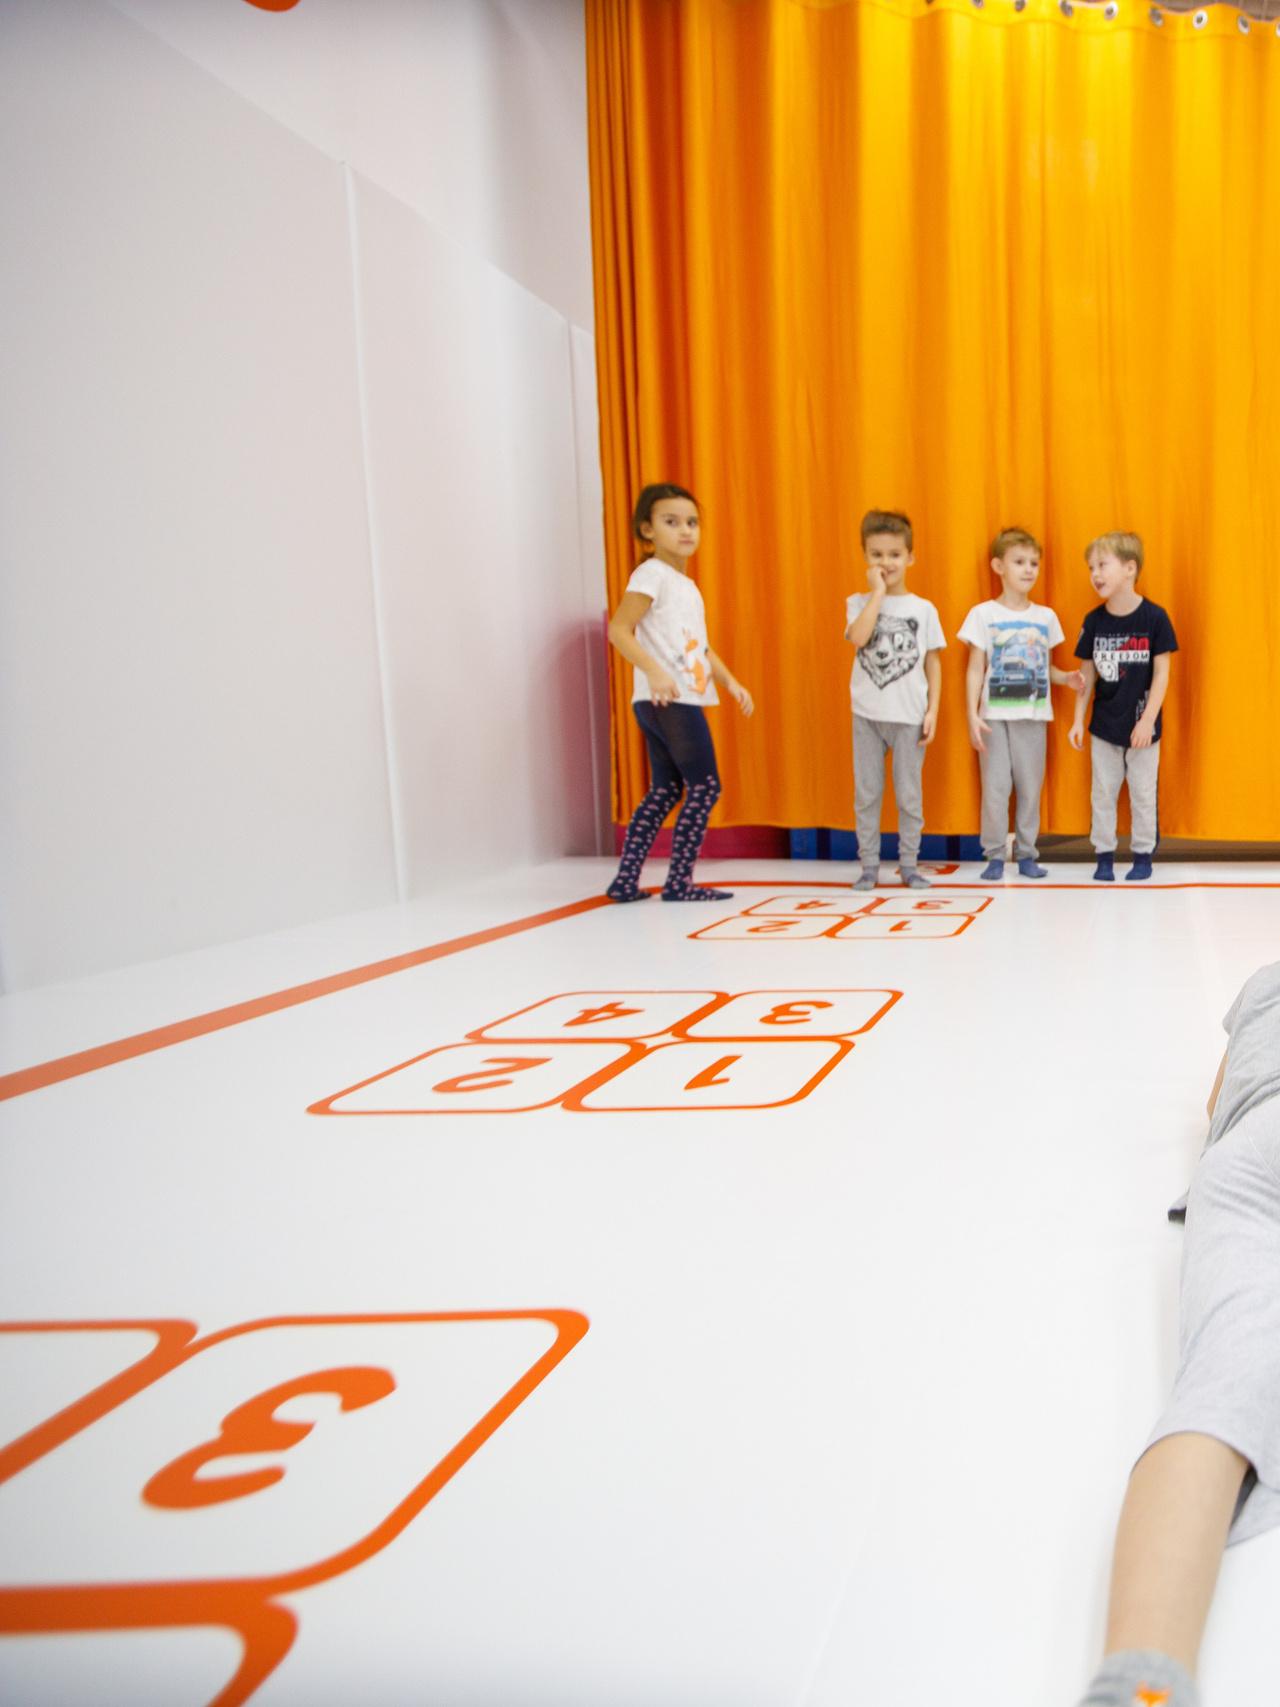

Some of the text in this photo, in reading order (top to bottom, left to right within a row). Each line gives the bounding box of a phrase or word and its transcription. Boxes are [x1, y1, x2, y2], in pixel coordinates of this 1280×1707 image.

[746, 919, 802, 934] 2
[563, 1001, 645, 1027] 4
[759, 1000, 835, 1025] 3
[432, 1056, 553, 1093] 2
[684, 1054, 743, 1091] 1
[140, 1365, 397, 1512] 3
